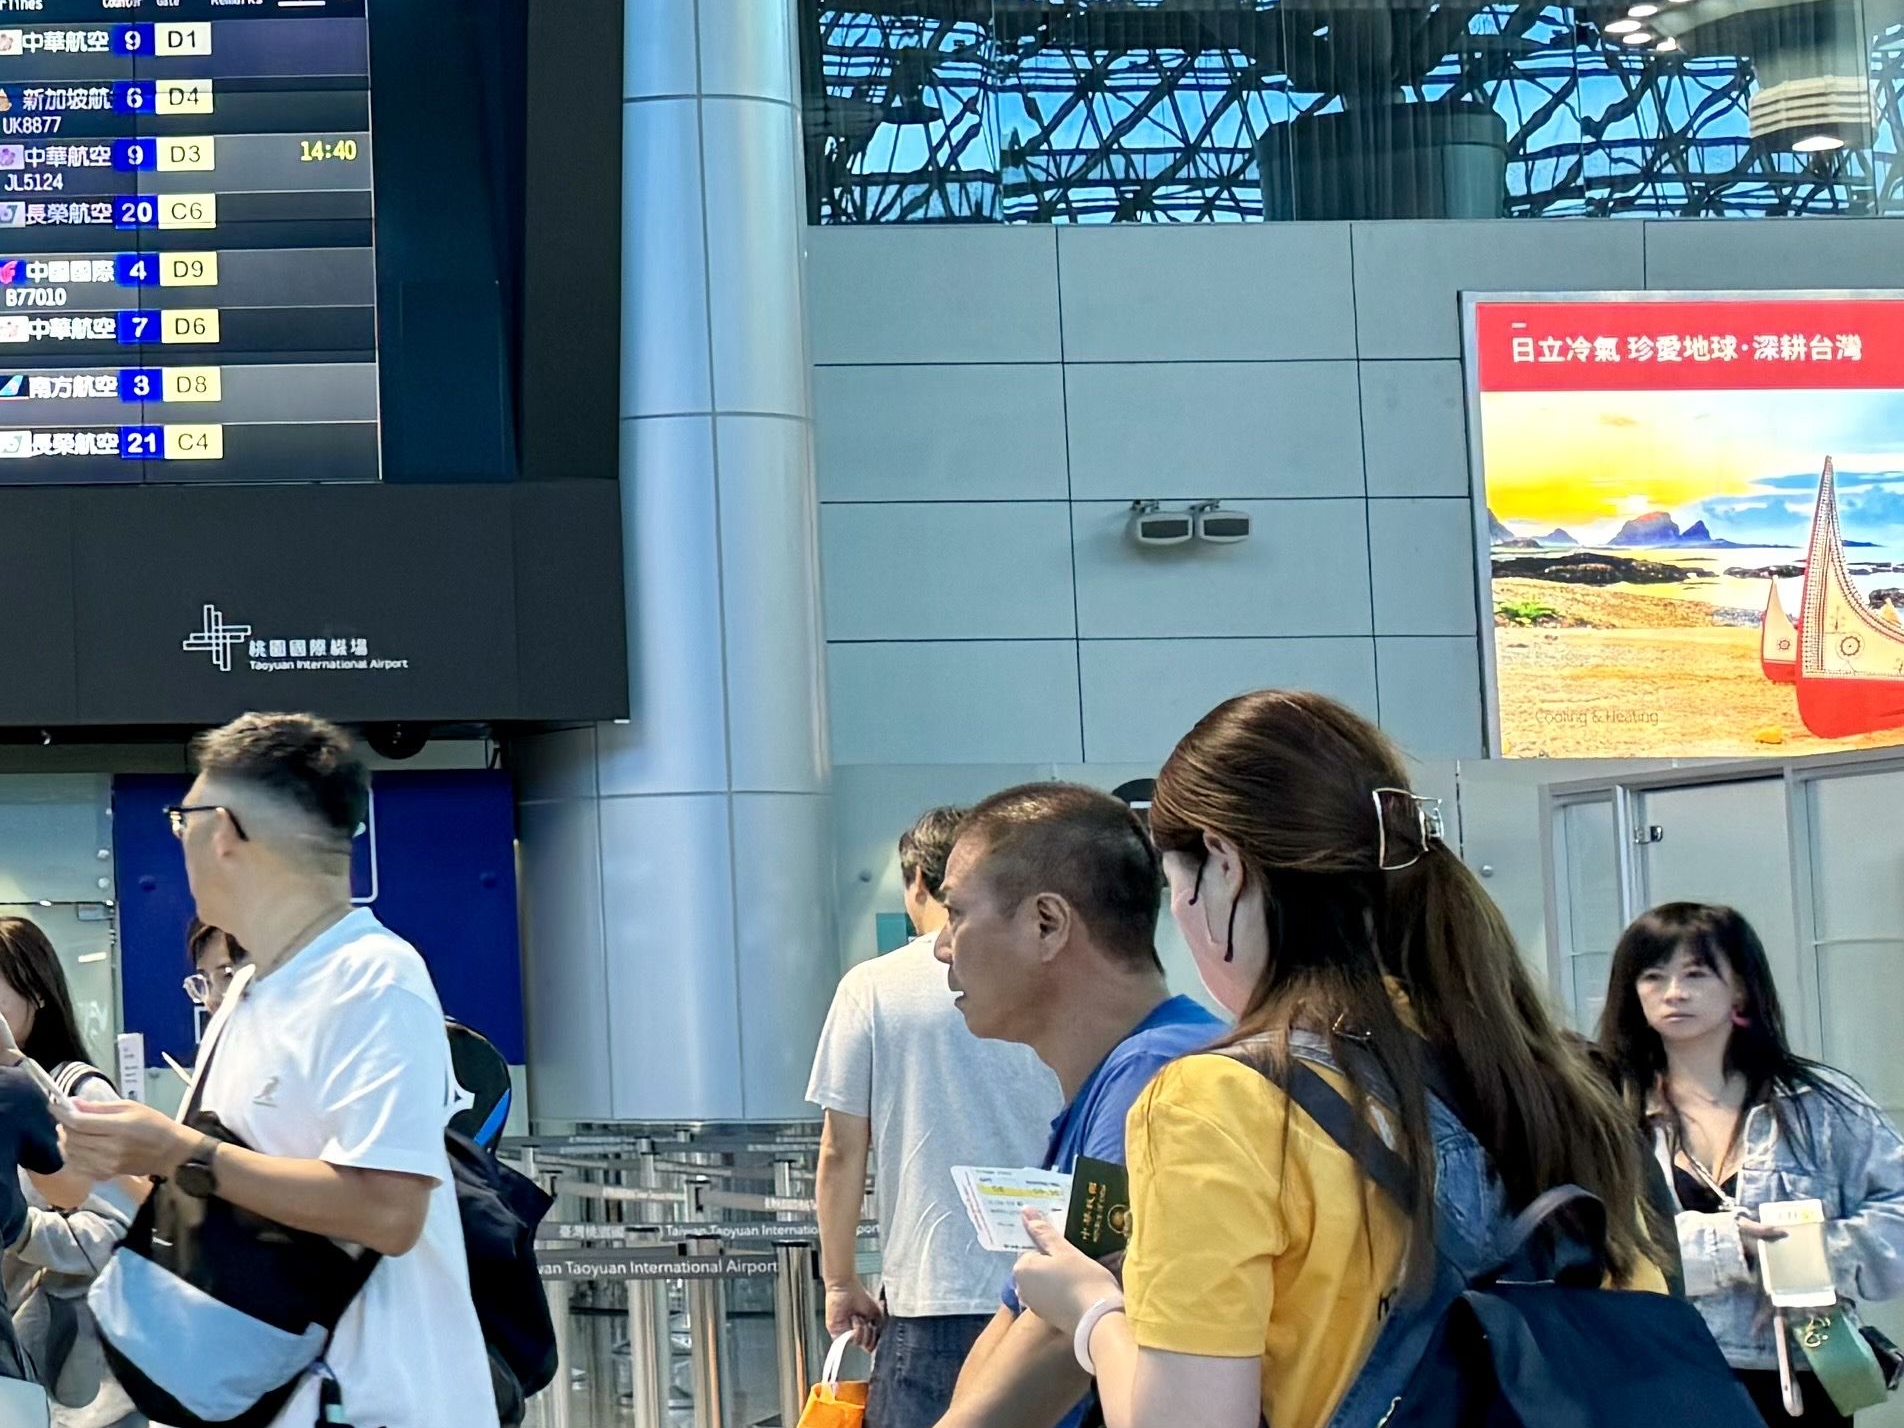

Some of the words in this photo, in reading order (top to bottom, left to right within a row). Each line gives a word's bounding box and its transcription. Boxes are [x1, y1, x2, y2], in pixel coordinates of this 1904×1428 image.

[301, 140, 356, 160] 14:40
[1512, 336, 1621, 363] 日立冷氣
[567, 1261, 626, 1277] Taoyuan
[630, 1260, 722, 1274] International
[726, 1259, 777, 1276] Airport
